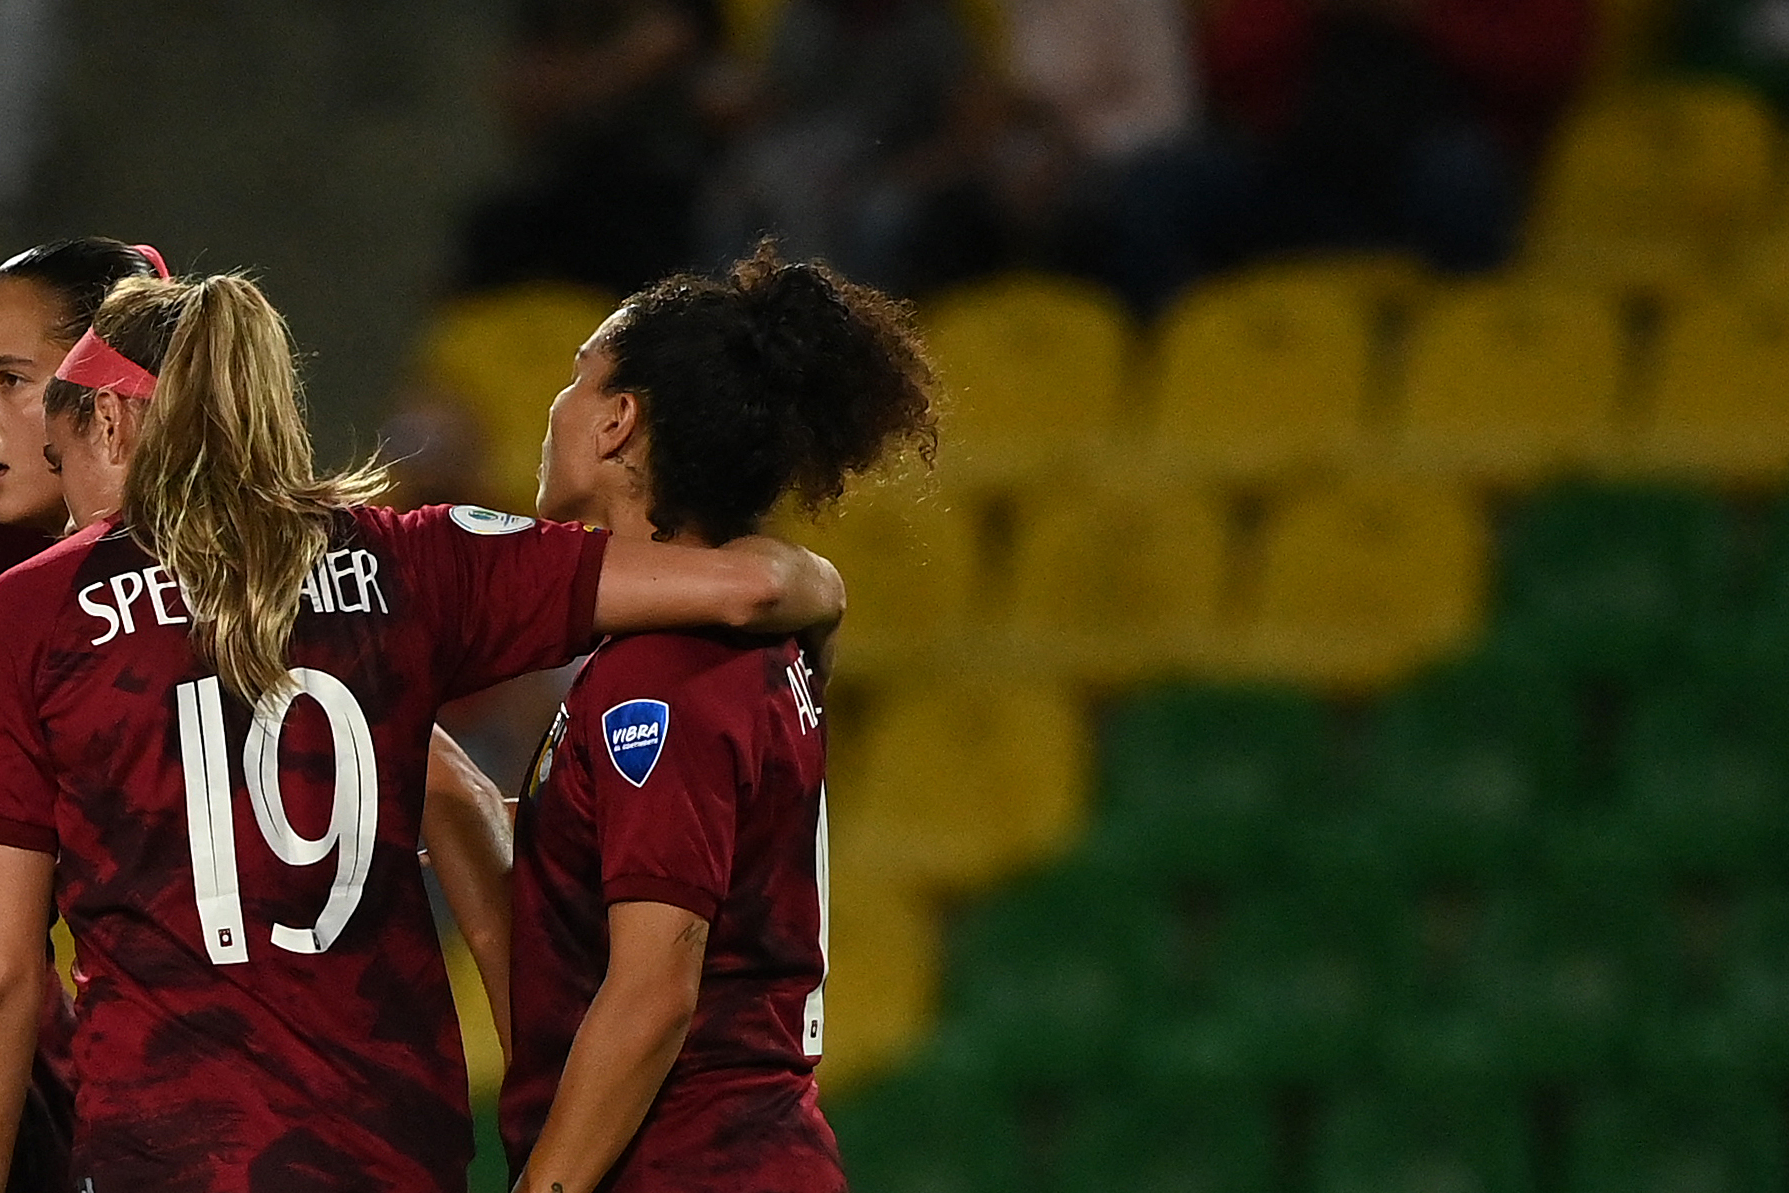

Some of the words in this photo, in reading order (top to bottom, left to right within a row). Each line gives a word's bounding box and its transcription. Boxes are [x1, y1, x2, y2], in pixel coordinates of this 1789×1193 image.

[77, 548, 389, 646] SPEAIER
[613, 721, 659, 745] VIBRA
[176, 667, 379, 965] 19
